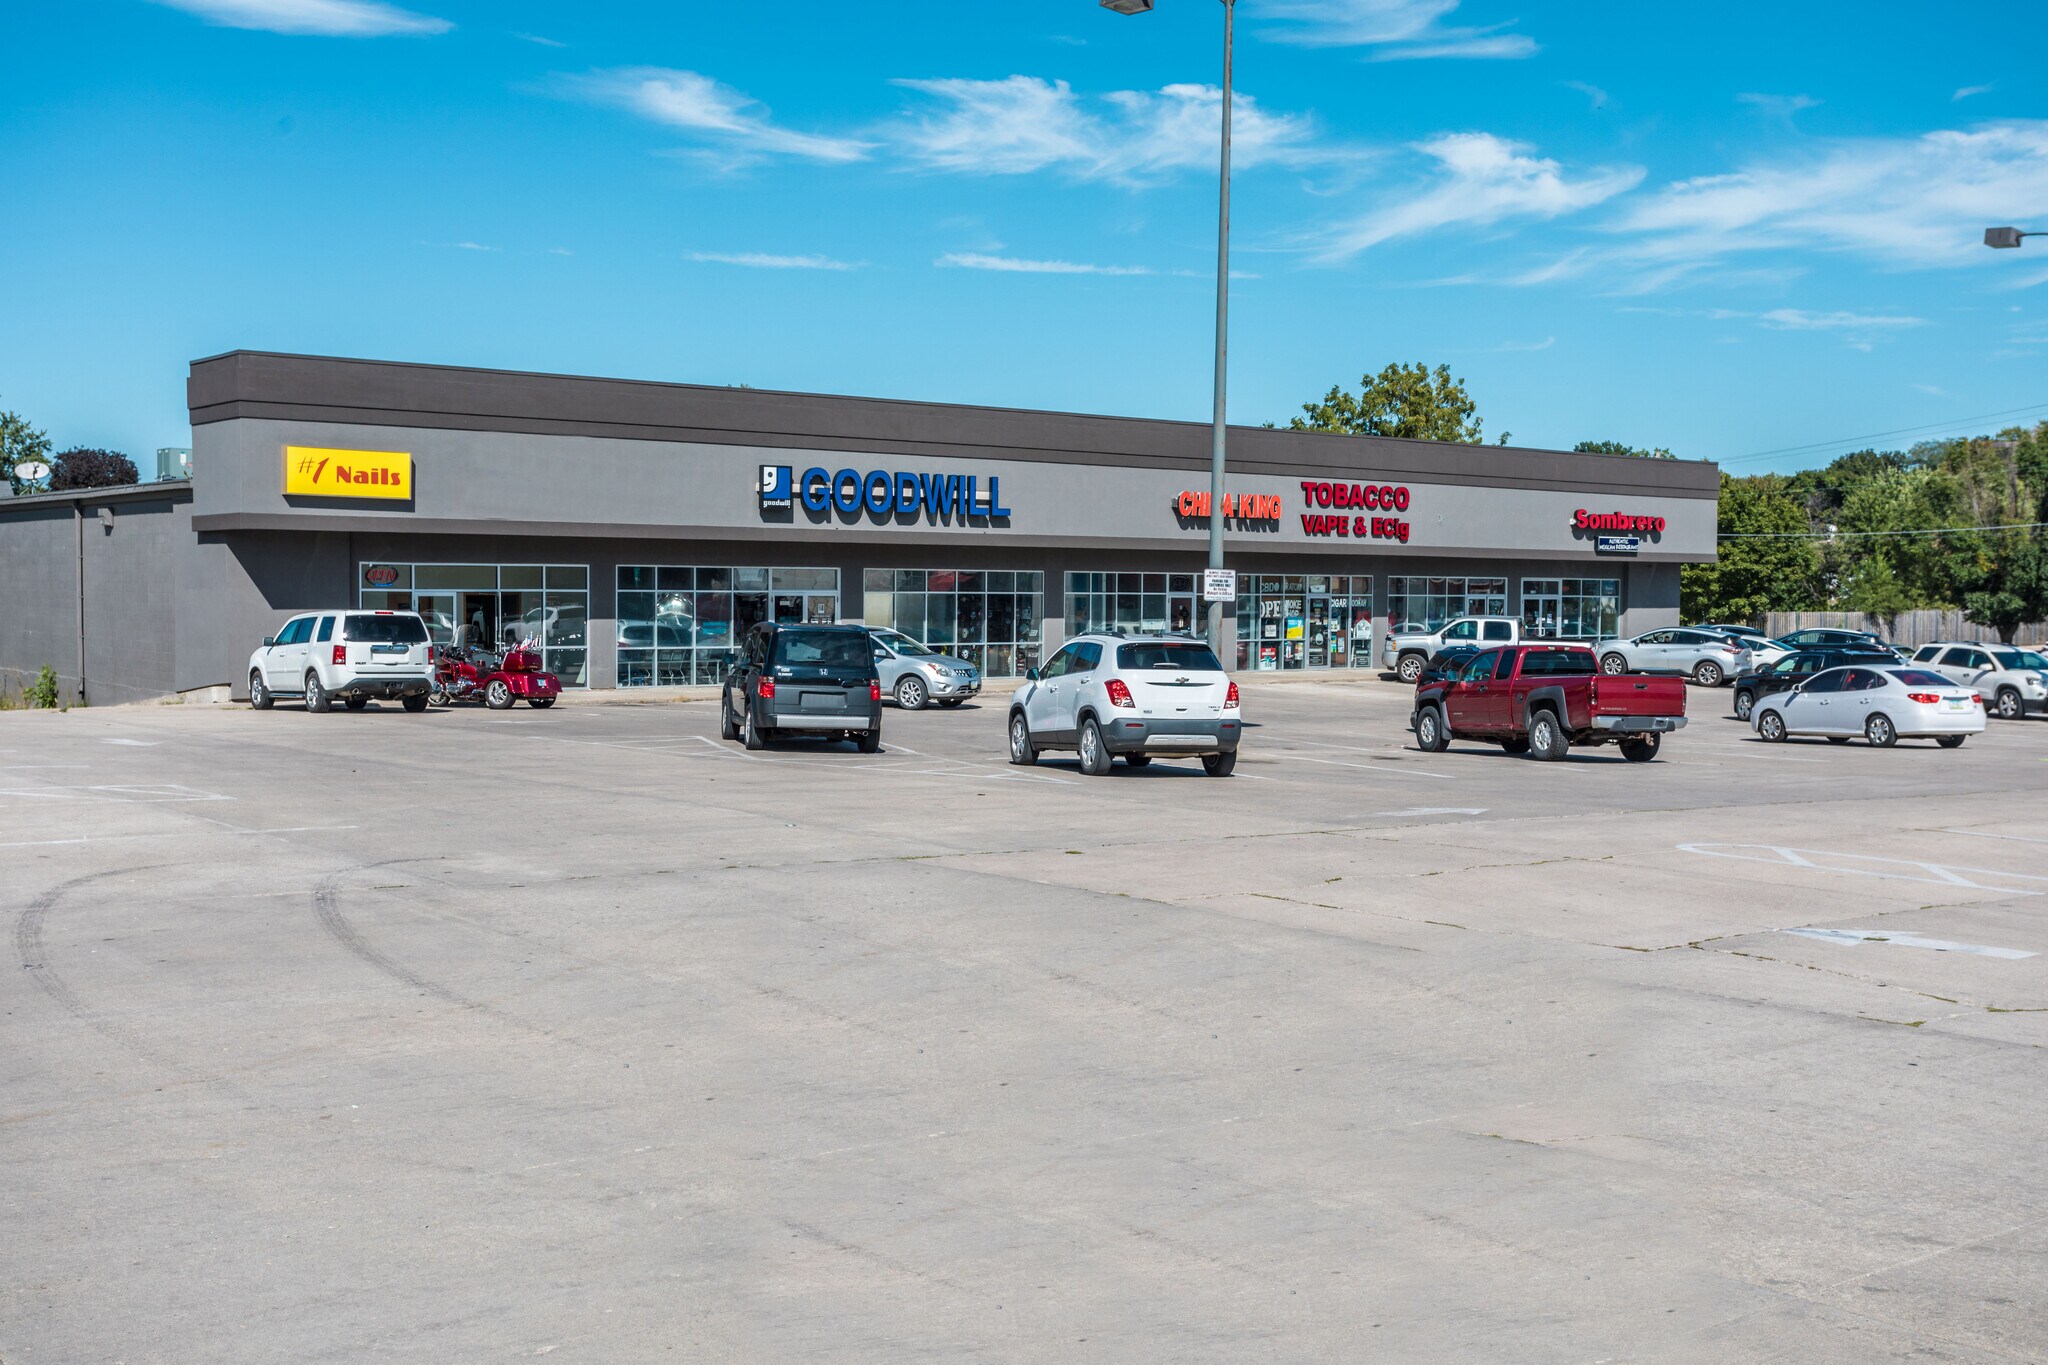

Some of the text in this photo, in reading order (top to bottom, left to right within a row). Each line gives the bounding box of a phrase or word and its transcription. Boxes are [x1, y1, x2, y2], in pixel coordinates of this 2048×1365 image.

[298, 457, 401, 486] #1 Nails
[763, 500, 791, 508] goodwill
[800, 467, 1011, 516] GOODWILL
[1179, 491, 1282, 519] CHIA KING
[1301, 482, 1410, 509] TOBACCO
[1301, 514, 1410, 541] VAPE & ECig
[1574, 508, 1666, 532] Sombrero
[367, 569, 397, 580] OPEN
